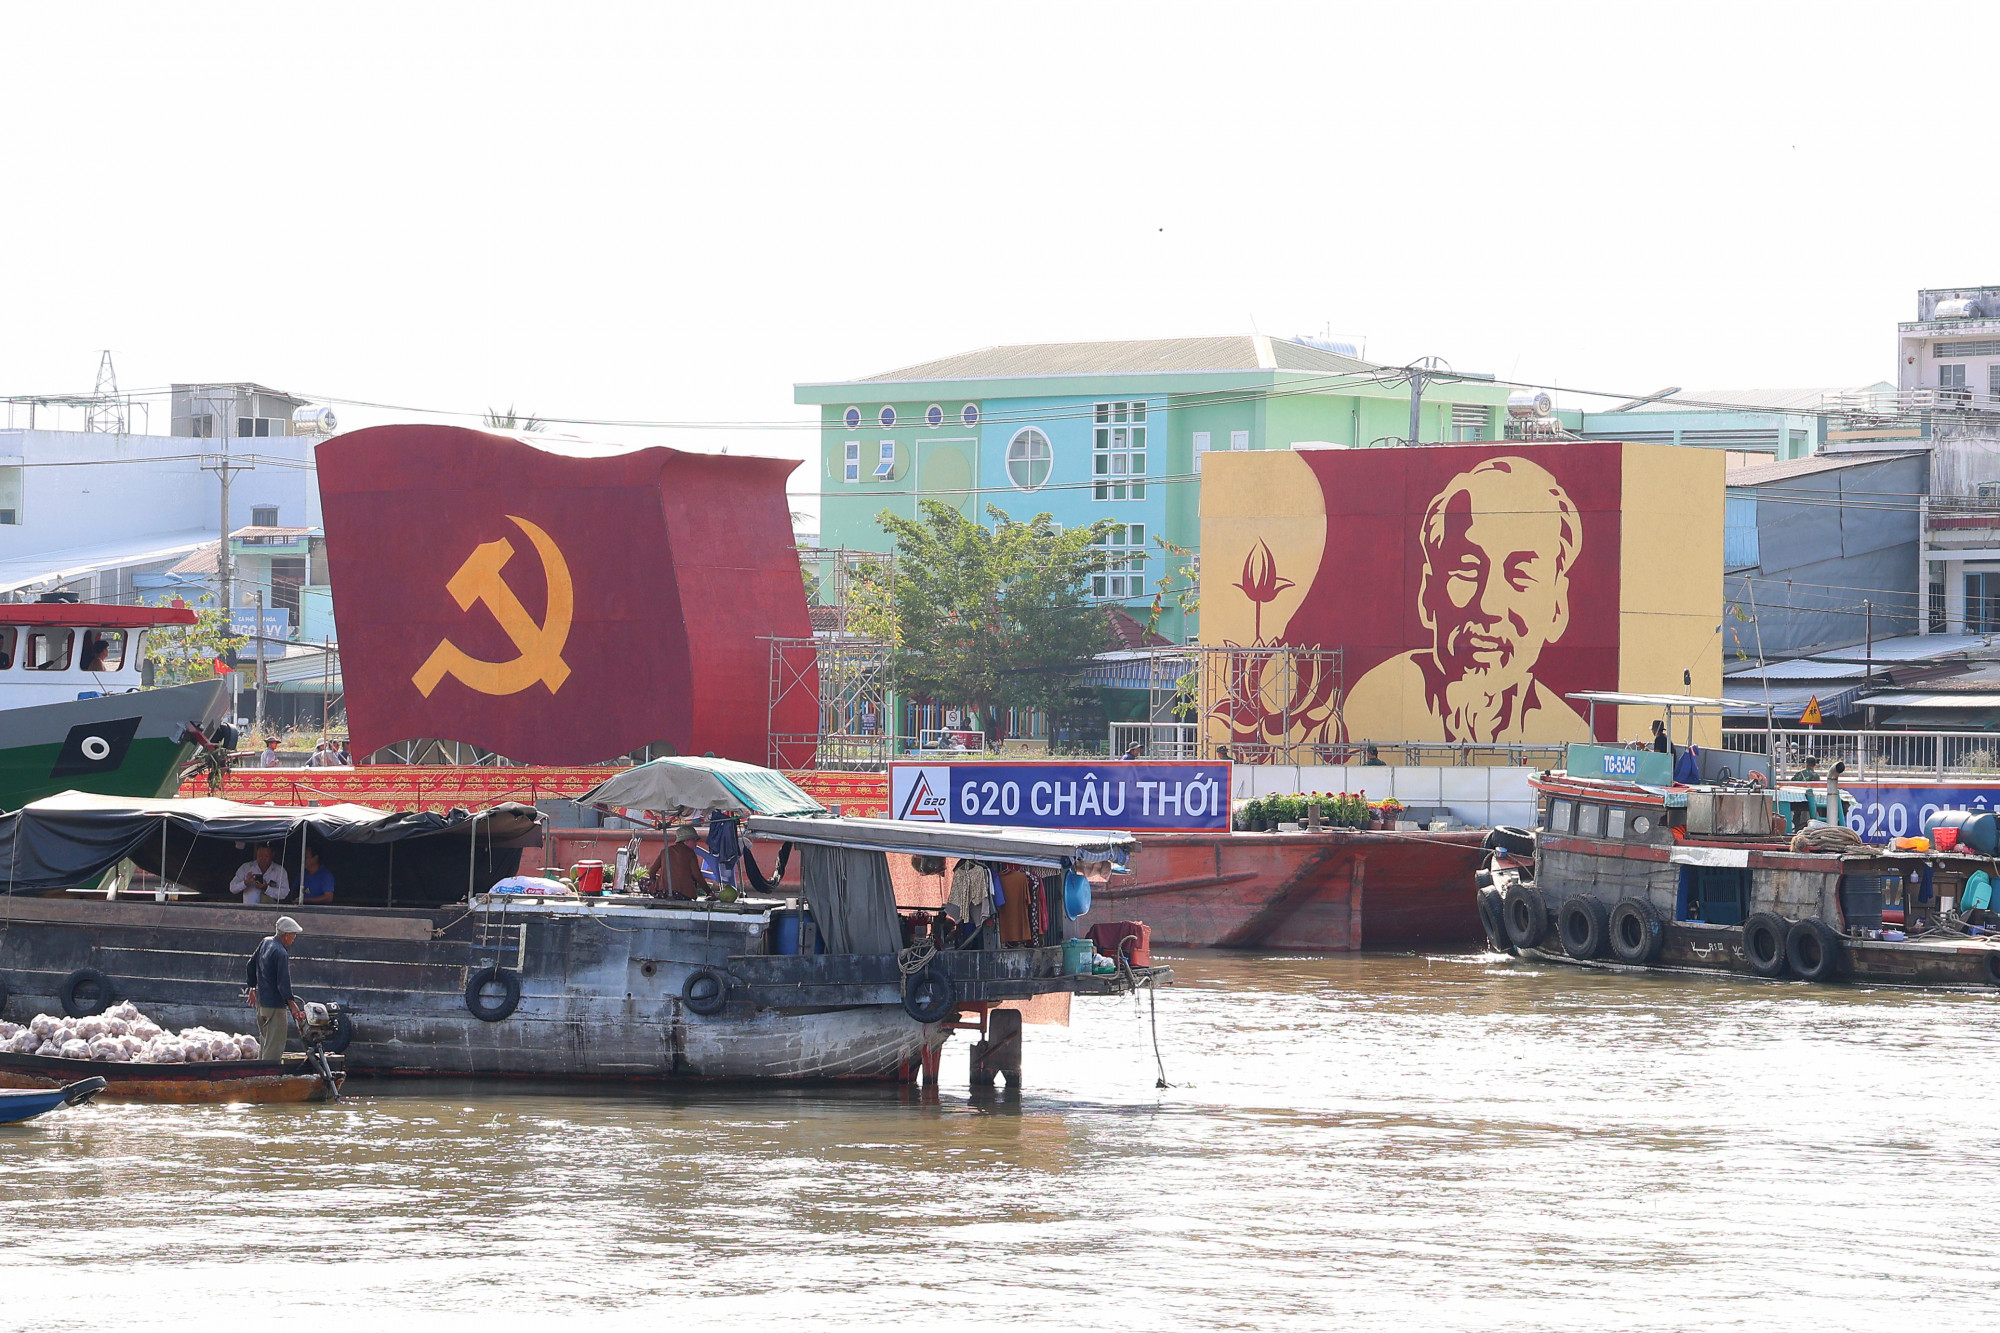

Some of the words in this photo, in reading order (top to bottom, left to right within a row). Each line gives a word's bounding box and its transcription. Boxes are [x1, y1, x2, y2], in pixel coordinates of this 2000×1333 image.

[266, 624, 282, 636] VY
[1603, 755, 1636, 774] TG-5345
[923, 797, 947, 806] 620
[961, 780, 1020, 817] 620
[1030, 772, 1127, 817] CHÂU
[1135, 772, 1220, 818] THỚI
[1846, 802, 1908, 838] 620
